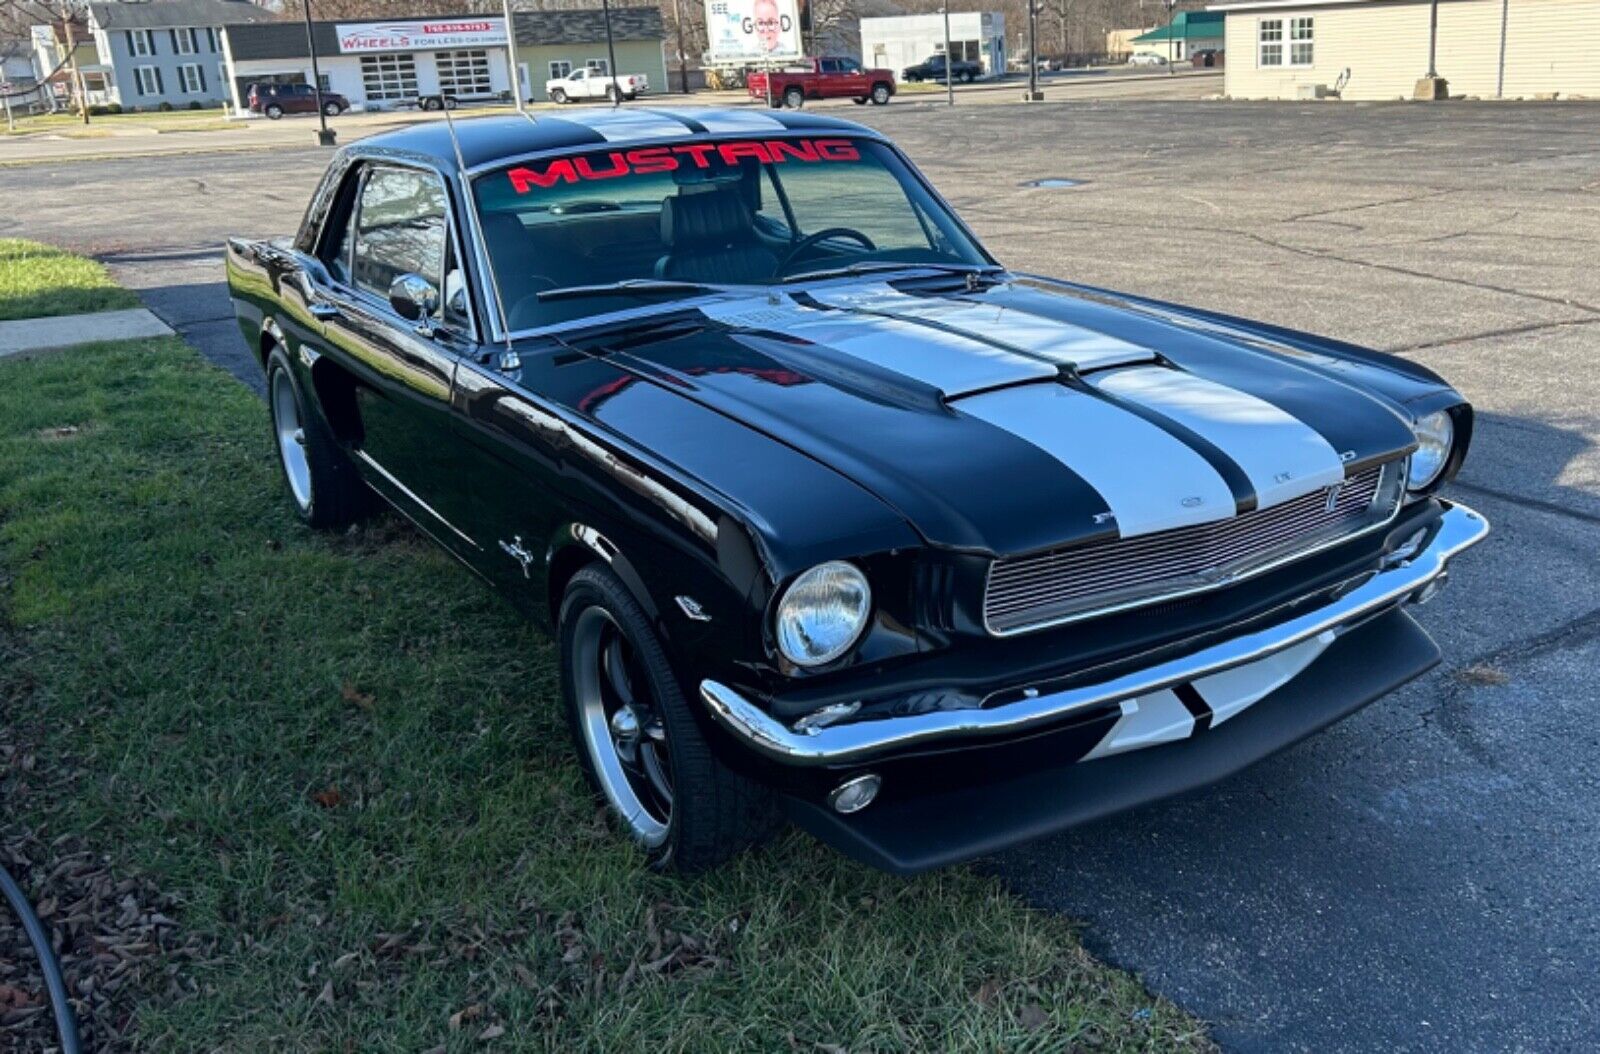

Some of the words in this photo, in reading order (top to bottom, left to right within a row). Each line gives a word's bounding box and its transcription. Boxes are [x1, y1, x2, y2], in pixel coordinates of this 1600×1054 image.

[711, 3, 729, 14] SEE
[342, 36, 410, 49] WHEELS
[414, 38, 436, 46] FOR
[438, 36, 464, 45] LESS
[508, 140, 860, 194] MUSTANG
